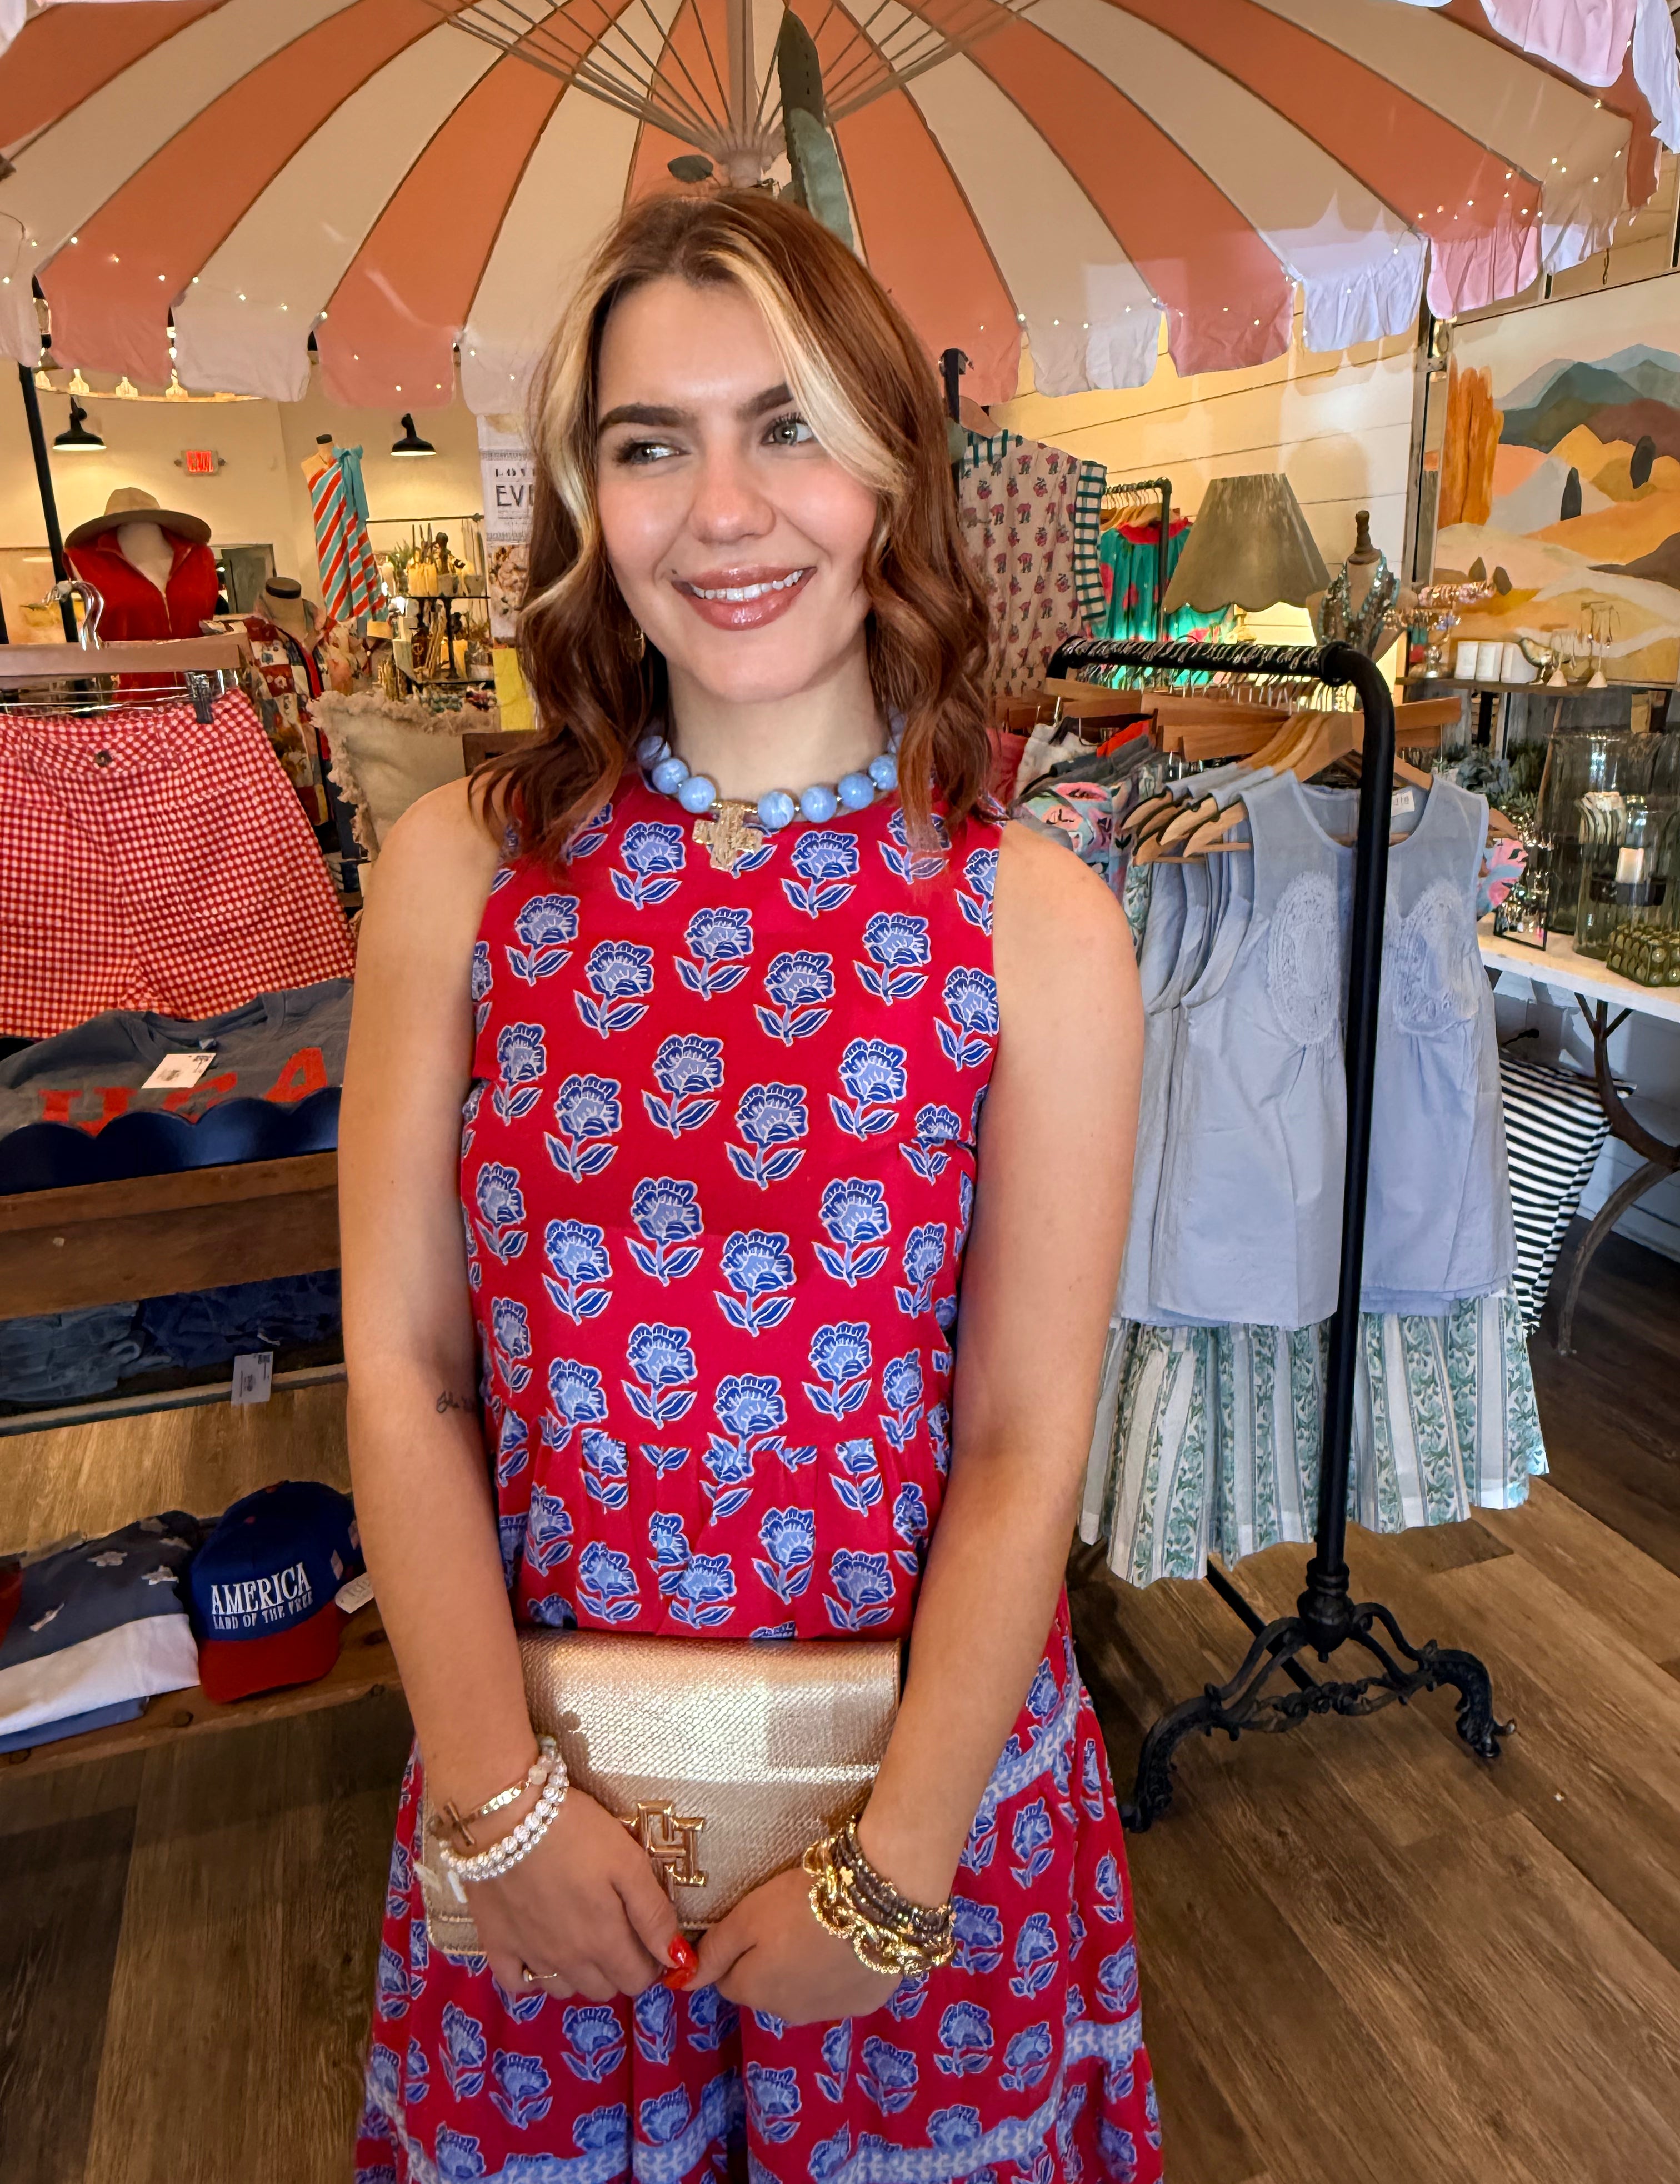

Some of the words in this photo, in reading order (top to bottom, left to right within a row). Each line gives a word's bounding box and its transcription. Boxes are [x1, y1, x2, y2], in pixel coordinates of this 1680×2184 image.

[211, 1562, 312, 1615] AMERICA
[213, 1615, 239, 1630] LAND
[243, 1613, 257, 1627] OF
[262, 1606, 285, 1623] THE
